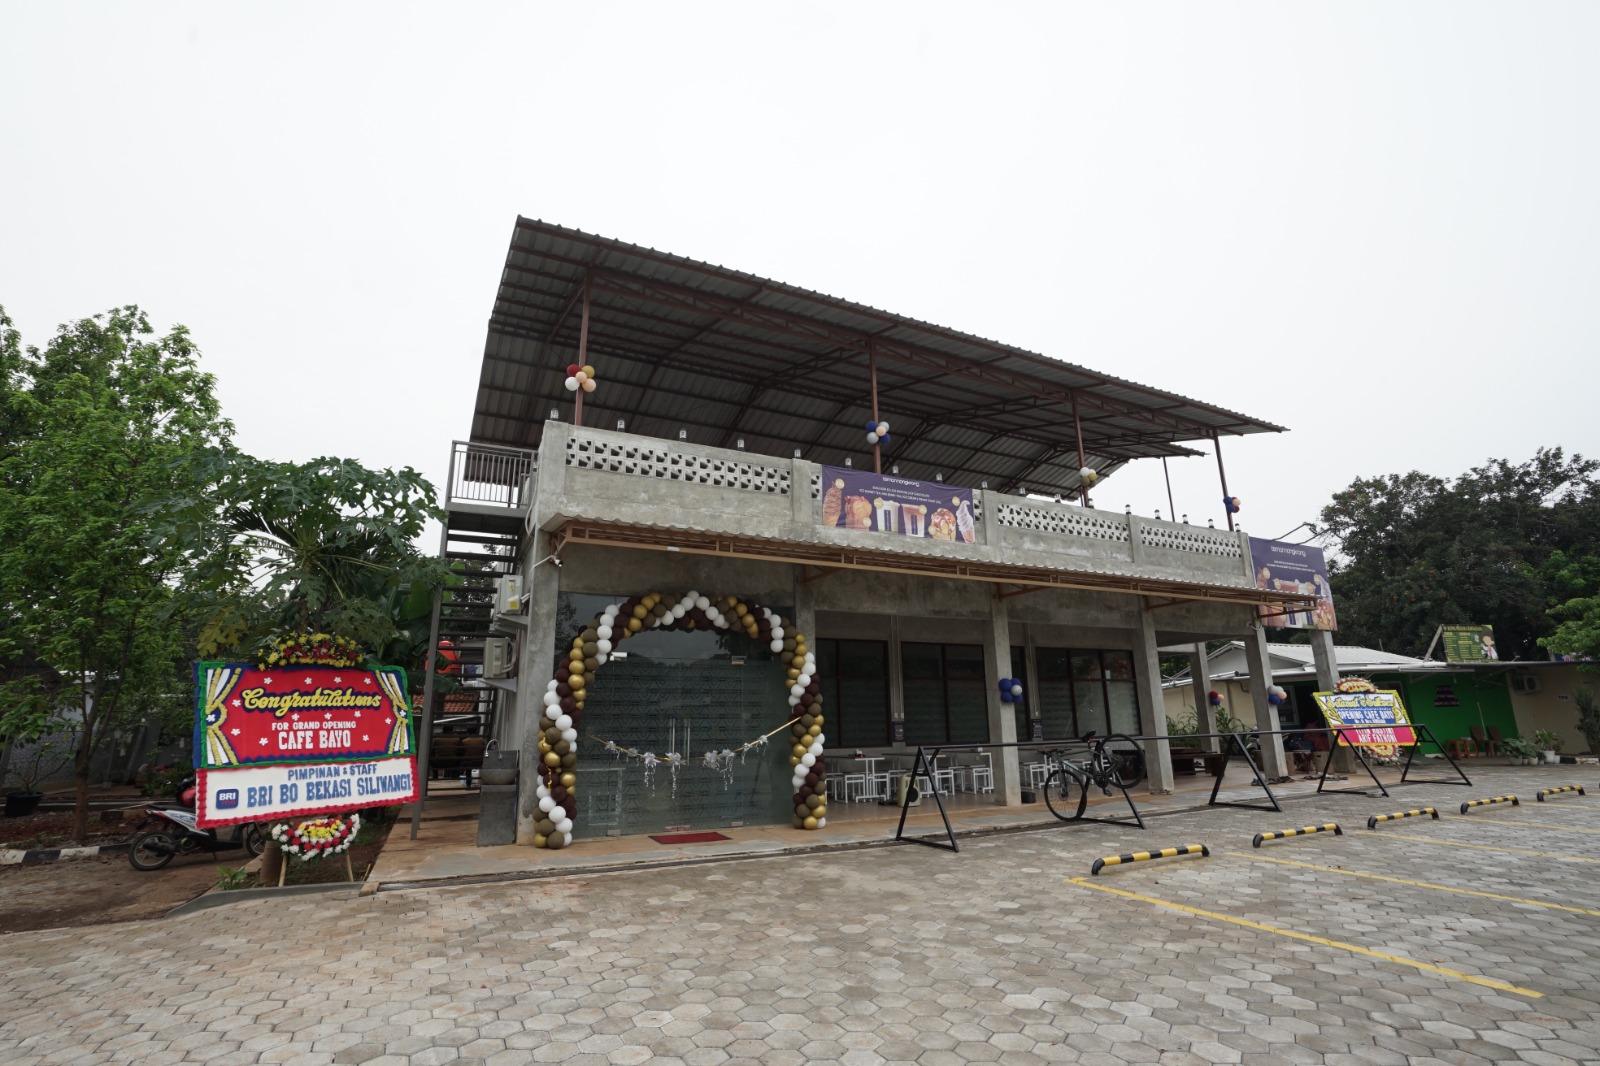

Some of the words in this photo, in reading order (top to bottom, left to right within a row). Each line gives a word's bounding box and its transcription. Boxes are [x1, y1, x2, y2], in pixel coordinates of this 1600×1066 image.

[241, 686, 382, 717] Congratulations
[1338, 711, 1364, 719] OPENING
[1365, 711, 1379, 719] CAFE
[272, 722, 289, 730] FOR
[293, 721, 320, 730] GRAND
[323, 720, 357, 730] OPENING
[278, 731, 314, 750] CAFE
[319, 730, 351, 749] BAYO
[288, 766, 340, 781] PIMPINAN
[343, 767, 348, 775] &
[349, 763, 377, 776] STAFF
[219, 791, 236, 800] BRI
[247, 786, 273, 808] BRI
[280, 784, 299, 804] BO
[306, 778, 351, 801] BEKASI
[357, 773, 412, 798] SILIWANGI
